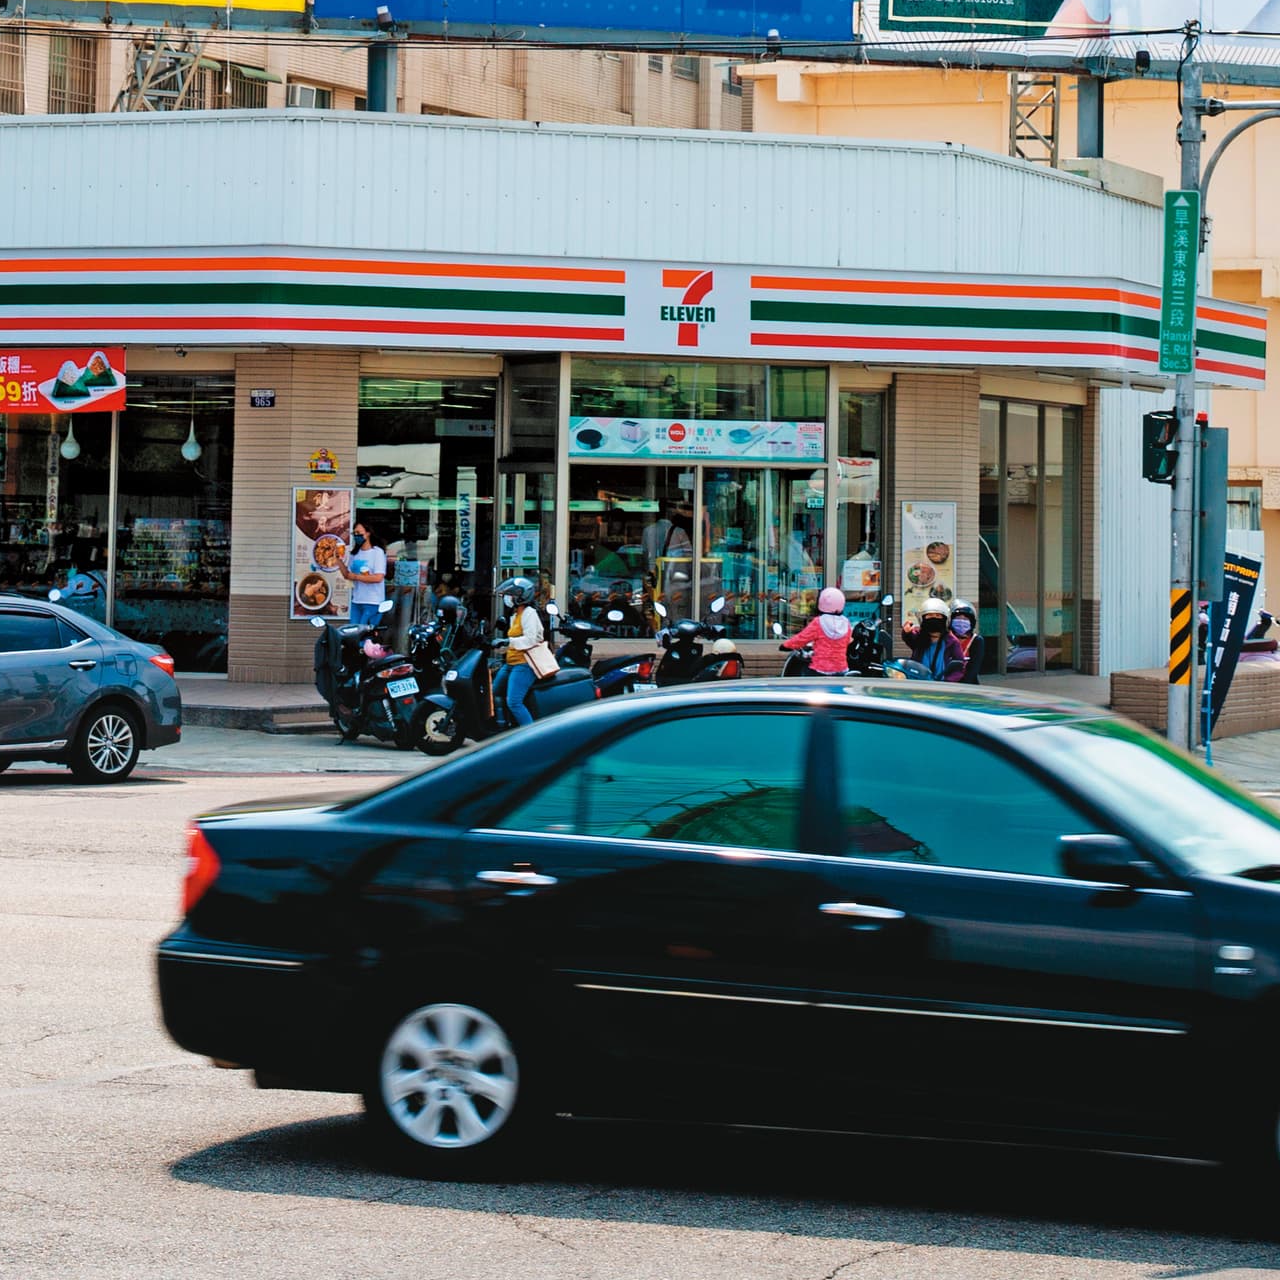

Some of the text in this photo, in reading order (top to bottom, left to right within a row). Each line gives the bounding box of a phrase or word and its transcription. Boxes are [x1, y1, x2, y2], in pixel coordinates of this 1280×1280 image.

[1170, 209, 1191, 327] 旱溪東路三段
[1163, 330, 1190, 341] Hanxi
[1163, 358, 1189, 369] Sec.3
[254, 397, 271, 406] 965
